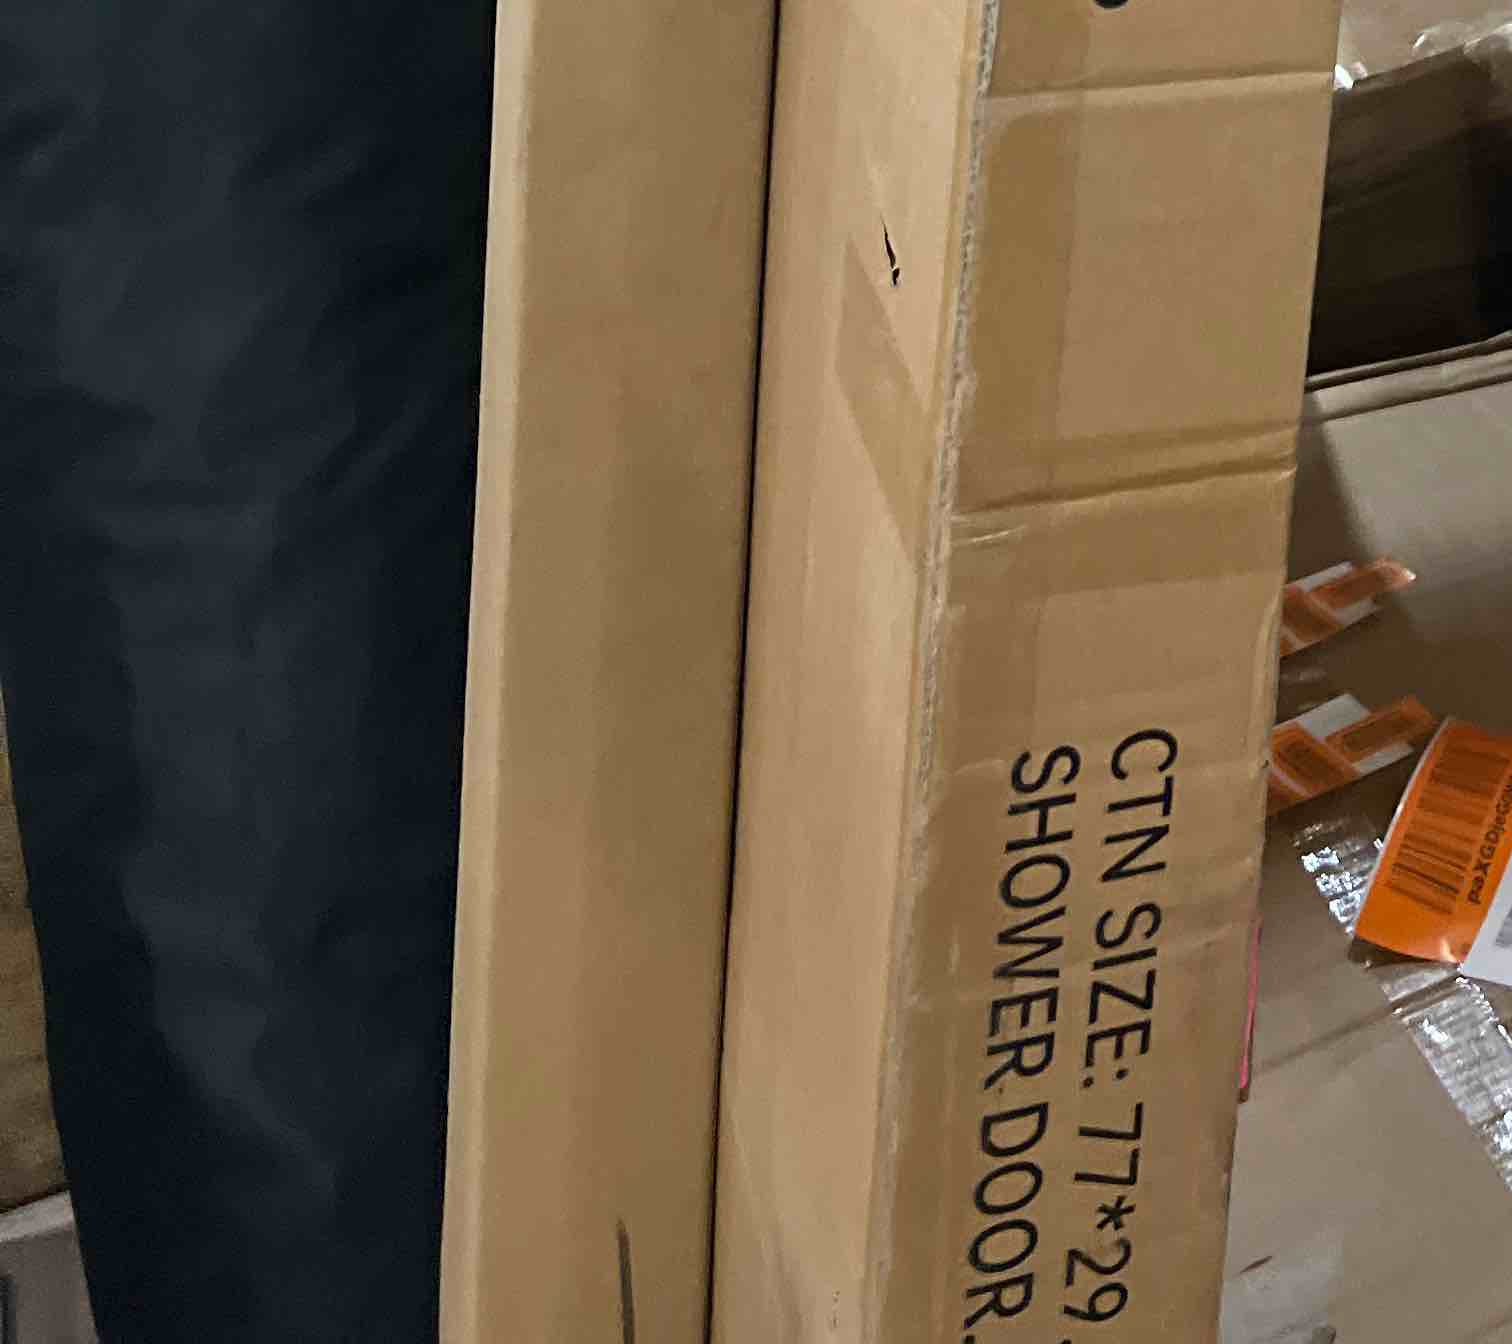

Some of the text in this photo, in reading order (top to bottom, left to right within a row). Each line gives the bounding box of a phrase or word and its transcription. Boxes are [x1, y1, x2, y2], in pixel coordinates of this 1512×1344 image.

[1101, 727, 1179, 884] CTN
[983, 743, 1082, 1091] SHOWER
[1081, 904, 1163, 1090] SIZE:
